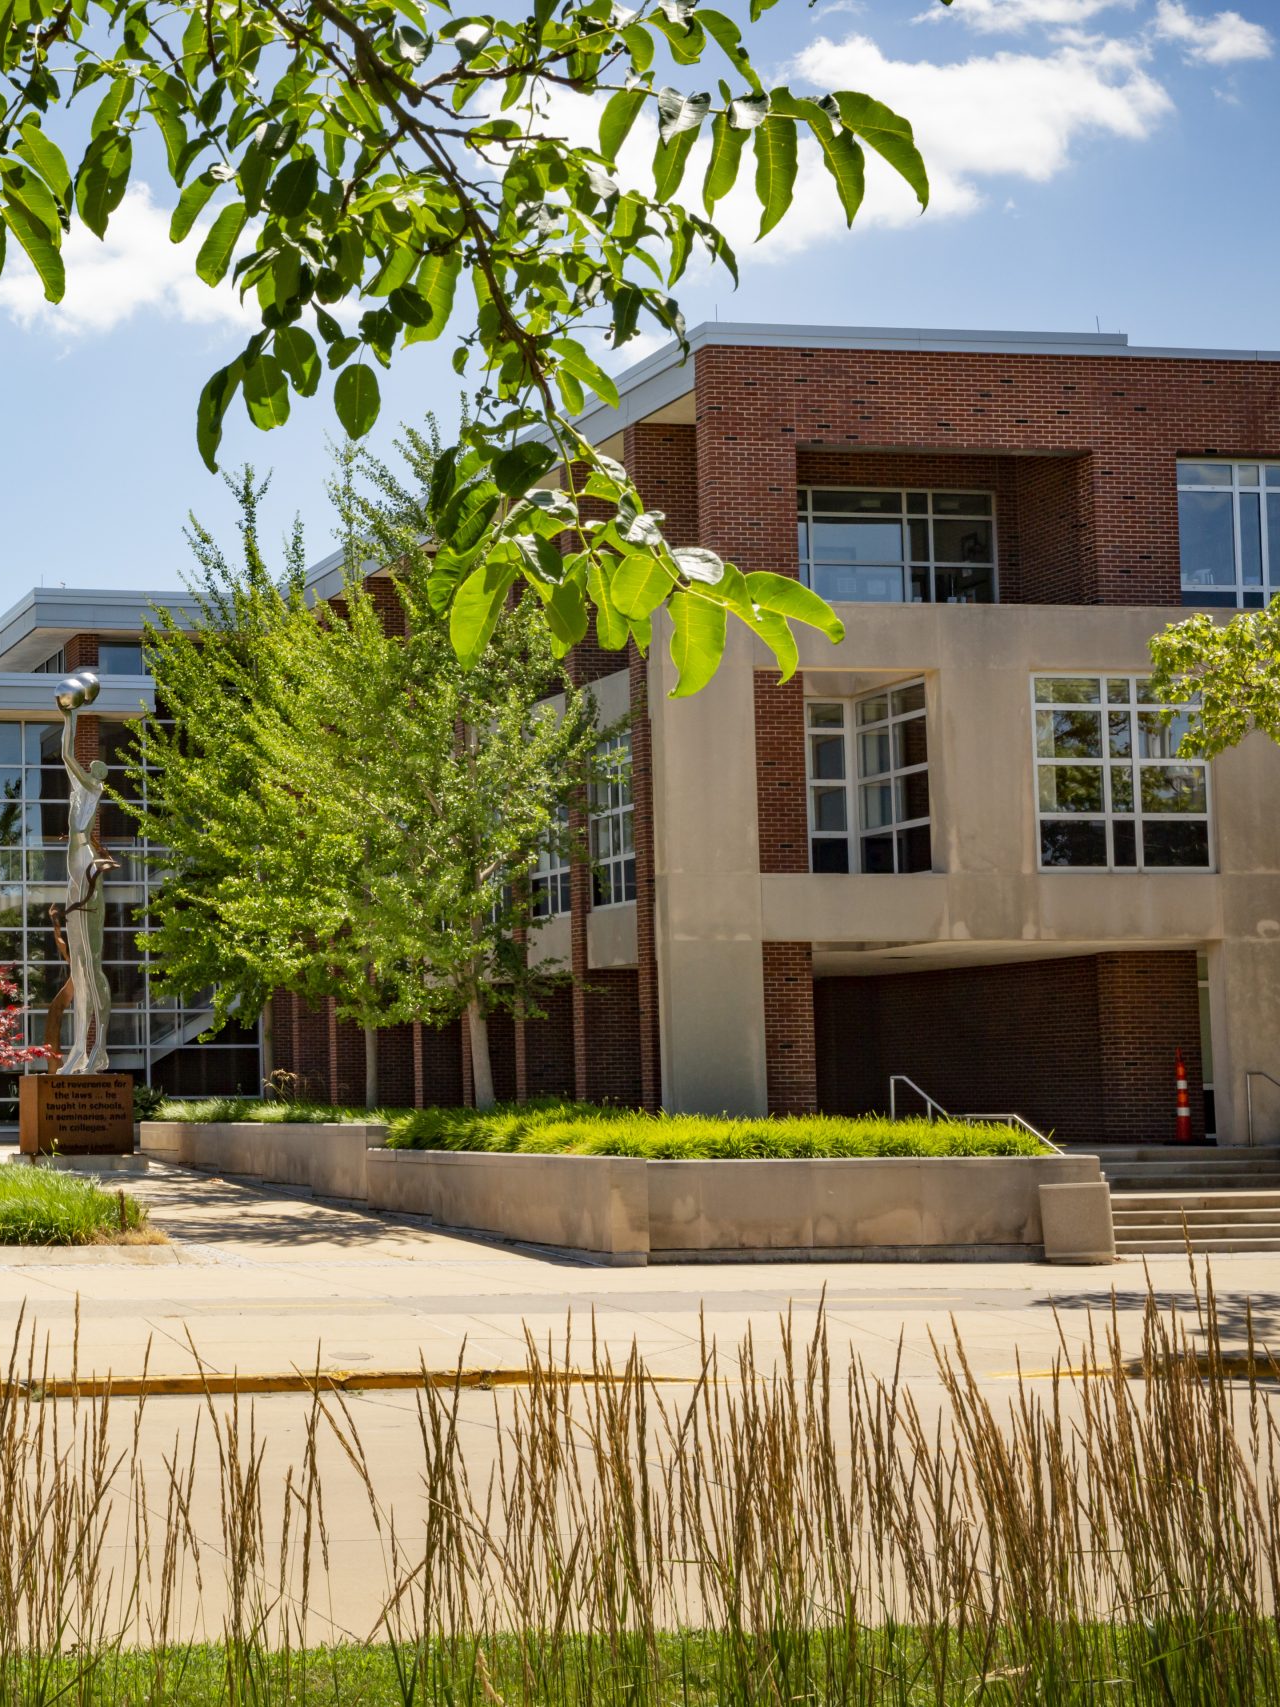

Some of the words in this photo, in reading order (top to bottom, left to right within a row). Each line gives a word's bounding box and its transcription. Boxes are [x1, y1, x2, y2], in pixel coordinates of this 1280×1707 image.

[67, 1081, 112, 1089] reverence
[113, 1079, 127, 1089] for
[54, 1090, 70, 1099] the
[71, 1090, 92, 1099] laws
[46, 1102, 76, 1112] taught
[78, 1102, 87, 1110] in
[45, 1113, 54, 1121] in
[109, 1112, 126, 1121] and
[58, 1123, 67, 1132] in
